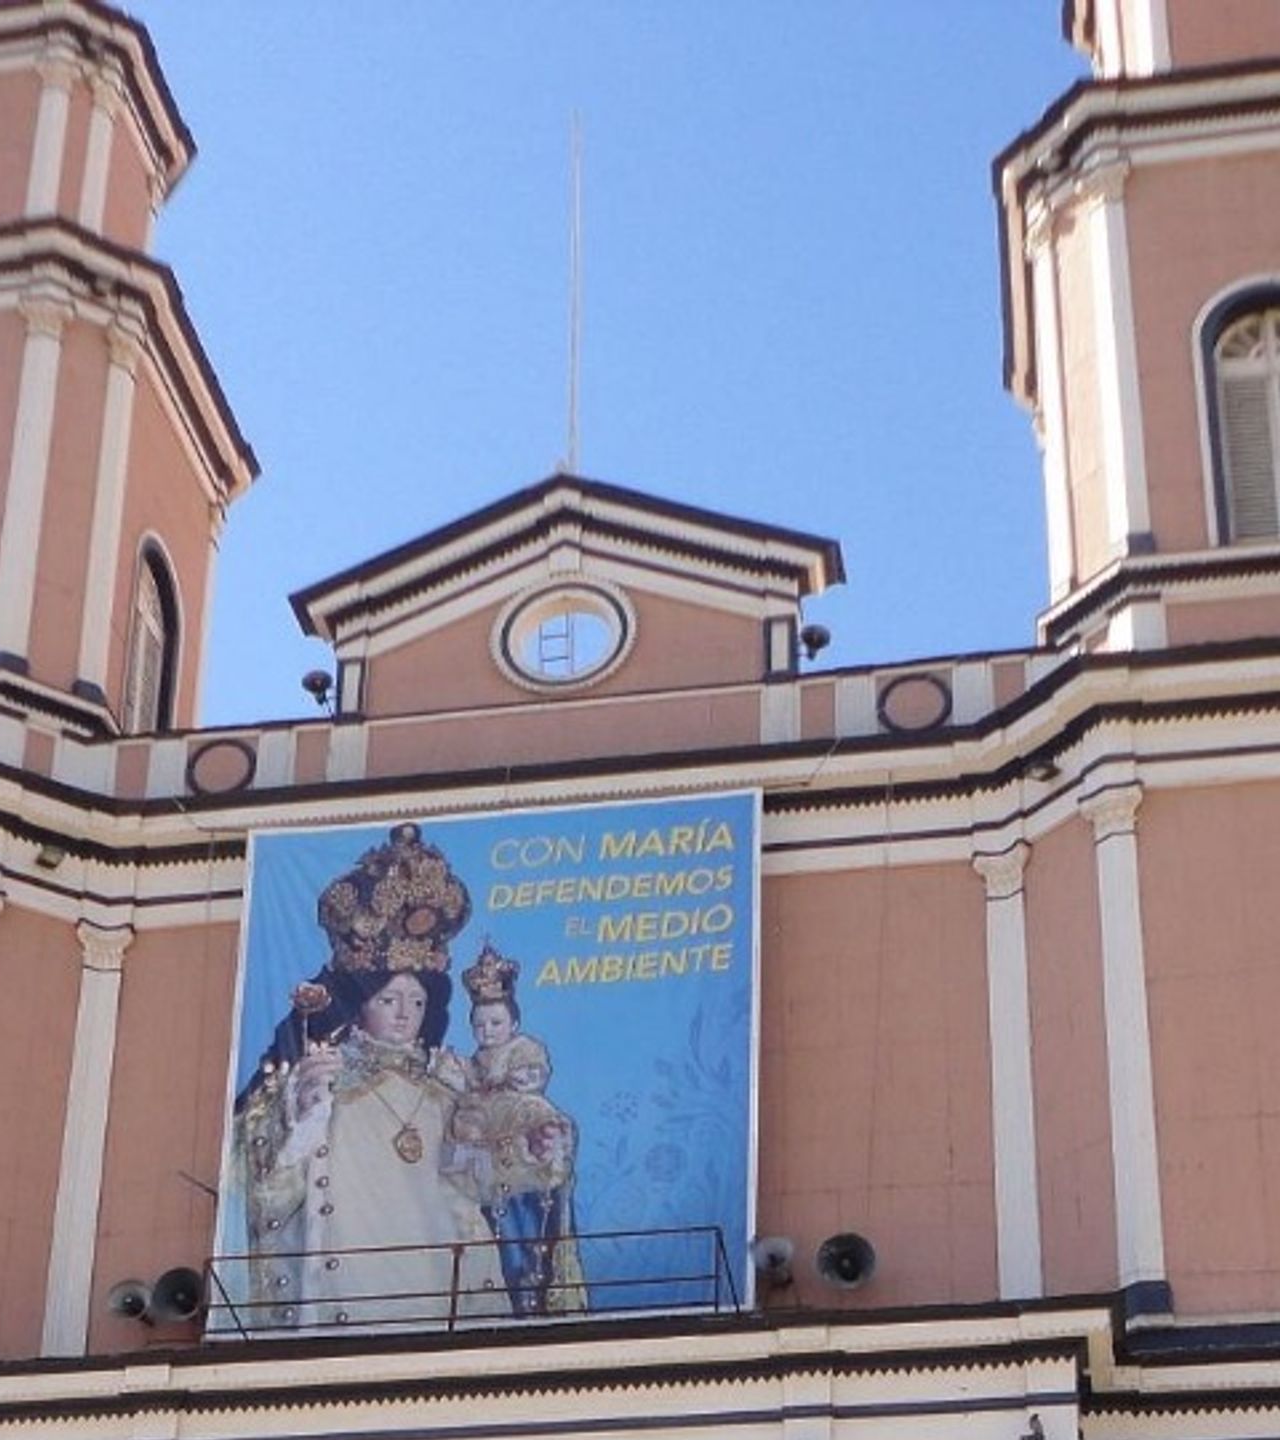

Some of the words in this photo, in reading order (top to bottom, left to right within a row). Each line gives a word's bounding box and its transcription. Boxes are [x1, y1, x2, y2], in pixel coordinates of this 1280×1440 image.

[491, 836, 584, 869] CON
[599, 818, 734, 861] MARÍA
[488, 864, 734, 911] DEFENDEMOS
[565, 916, 593, 937] EL
[596, 903, 734, 943] MEDIO
[535, 944, 733, 987] AMBIENTE
